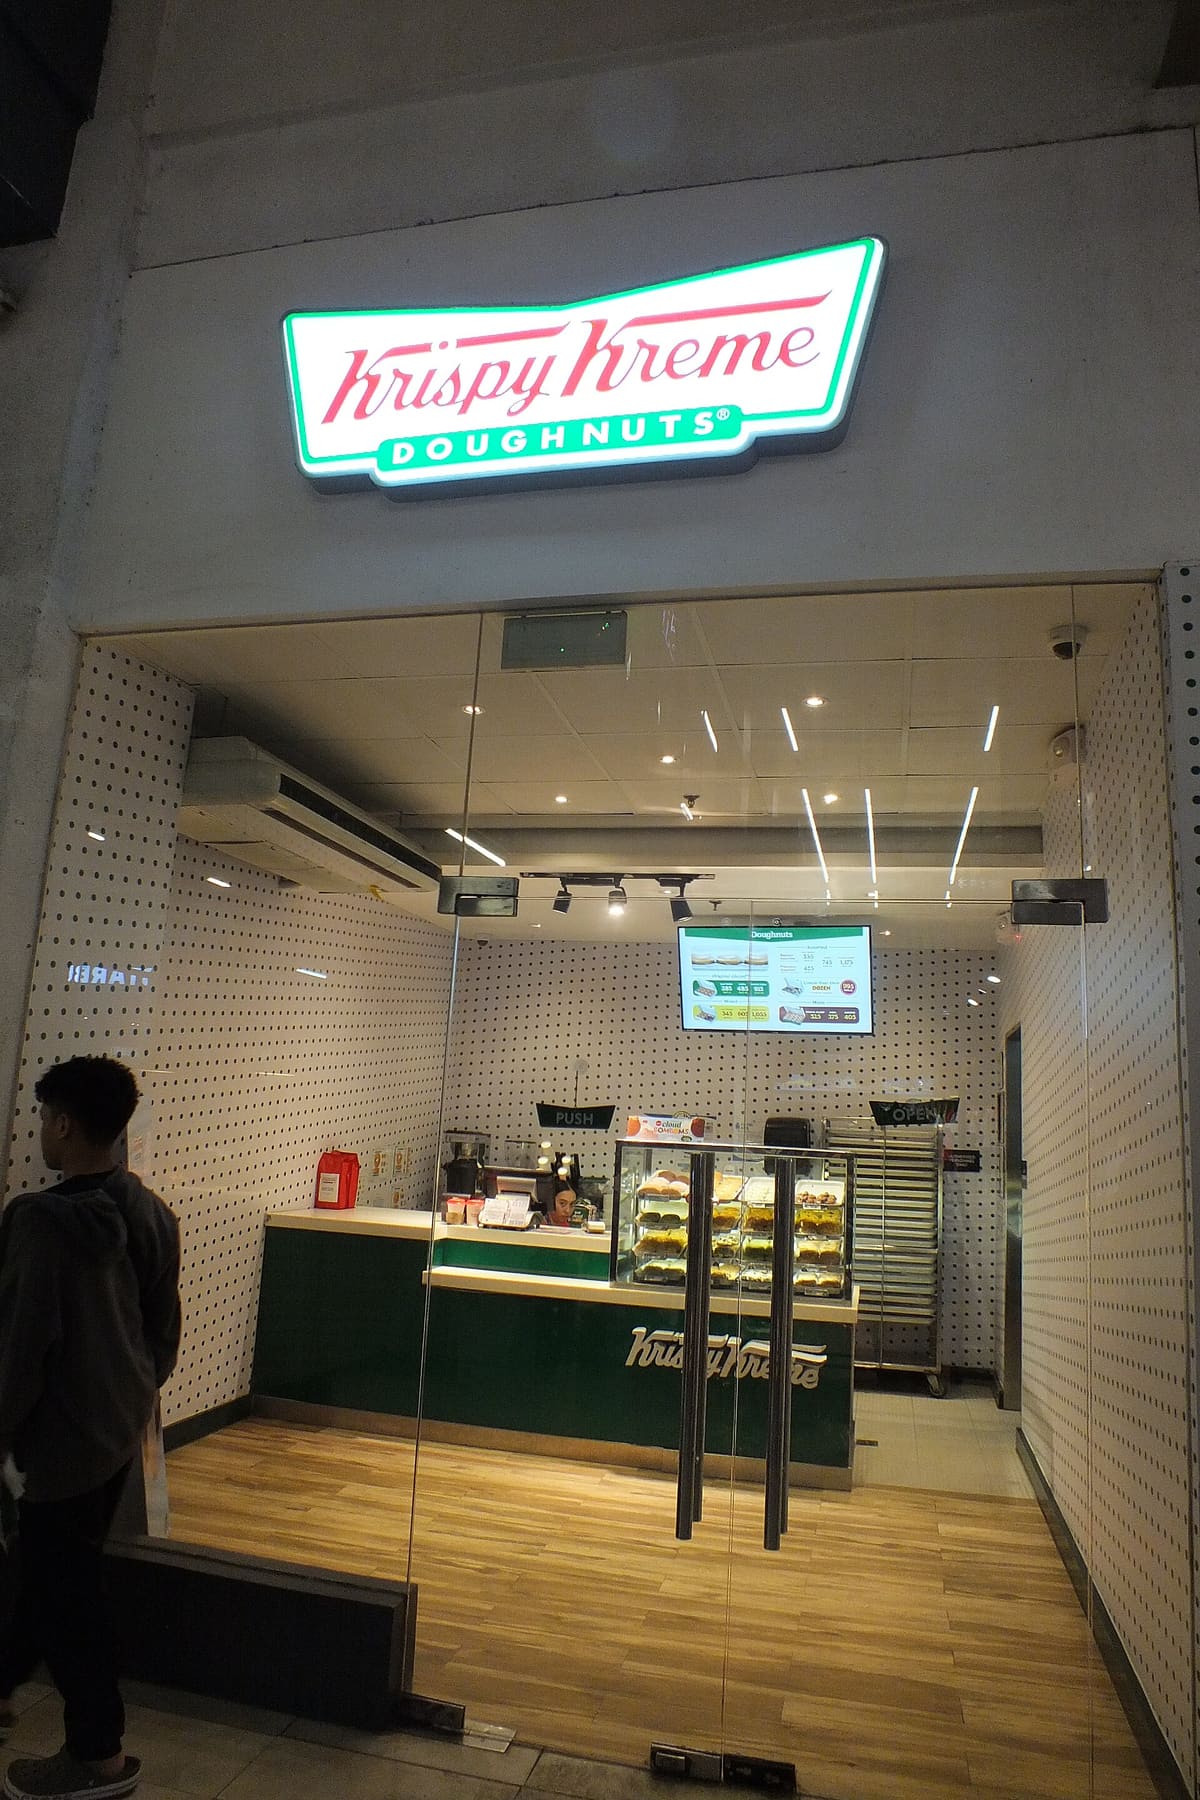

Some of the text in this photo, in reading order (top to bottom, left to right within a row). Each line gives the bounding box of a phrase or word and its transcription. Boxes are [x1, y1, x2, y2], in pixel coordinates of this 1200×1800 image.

[322, 290, 831, 423] Krispy Kreme
[751, 931, 793, 940] Doughnuts
[556, 1111, 593, 1126] PUSH
[662, 1120, 683, 1128] cloud
[625, 1326, 729, 1380] Krisy
